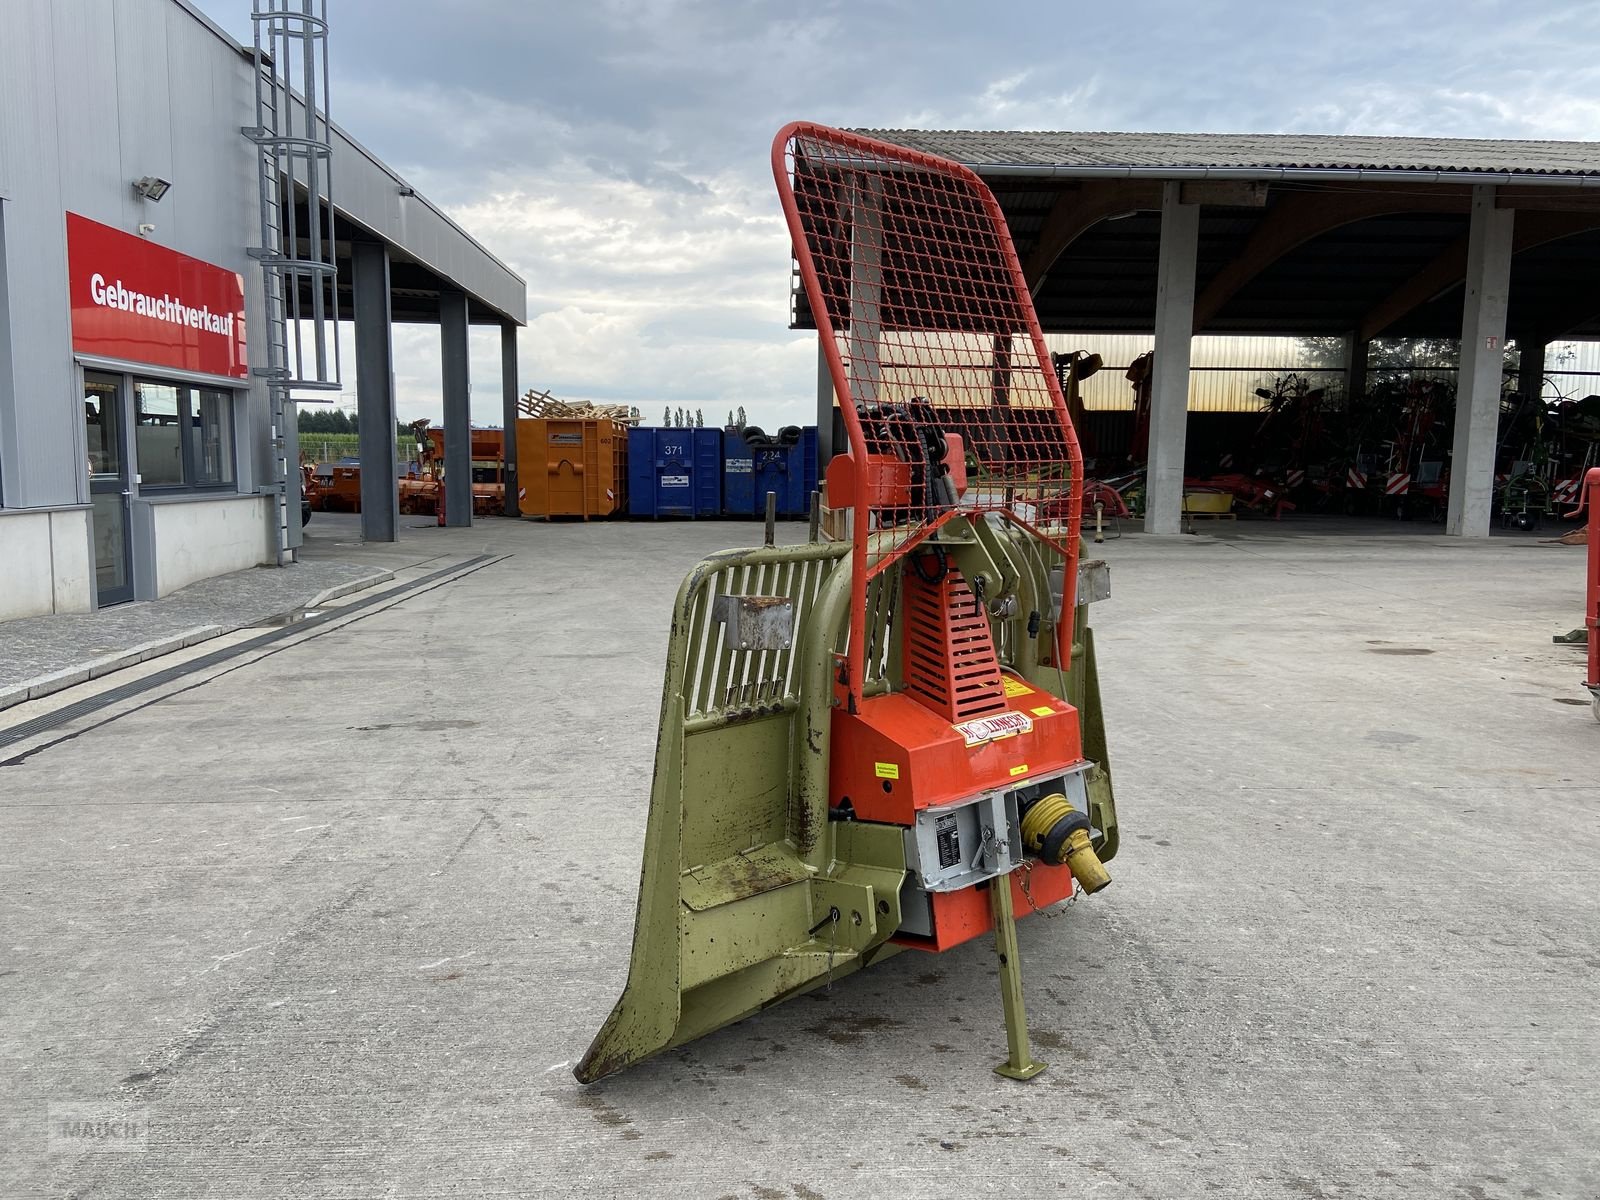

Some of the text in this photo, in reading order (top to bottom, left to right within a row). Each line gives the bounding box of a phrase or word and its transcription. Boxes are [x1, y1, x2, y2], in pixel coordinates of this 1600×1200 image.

[90, 273, 234, 337] Gebrauchtverkauf
[665, 445, 682, 455] 371
[762, 450, 781, 460] 224
